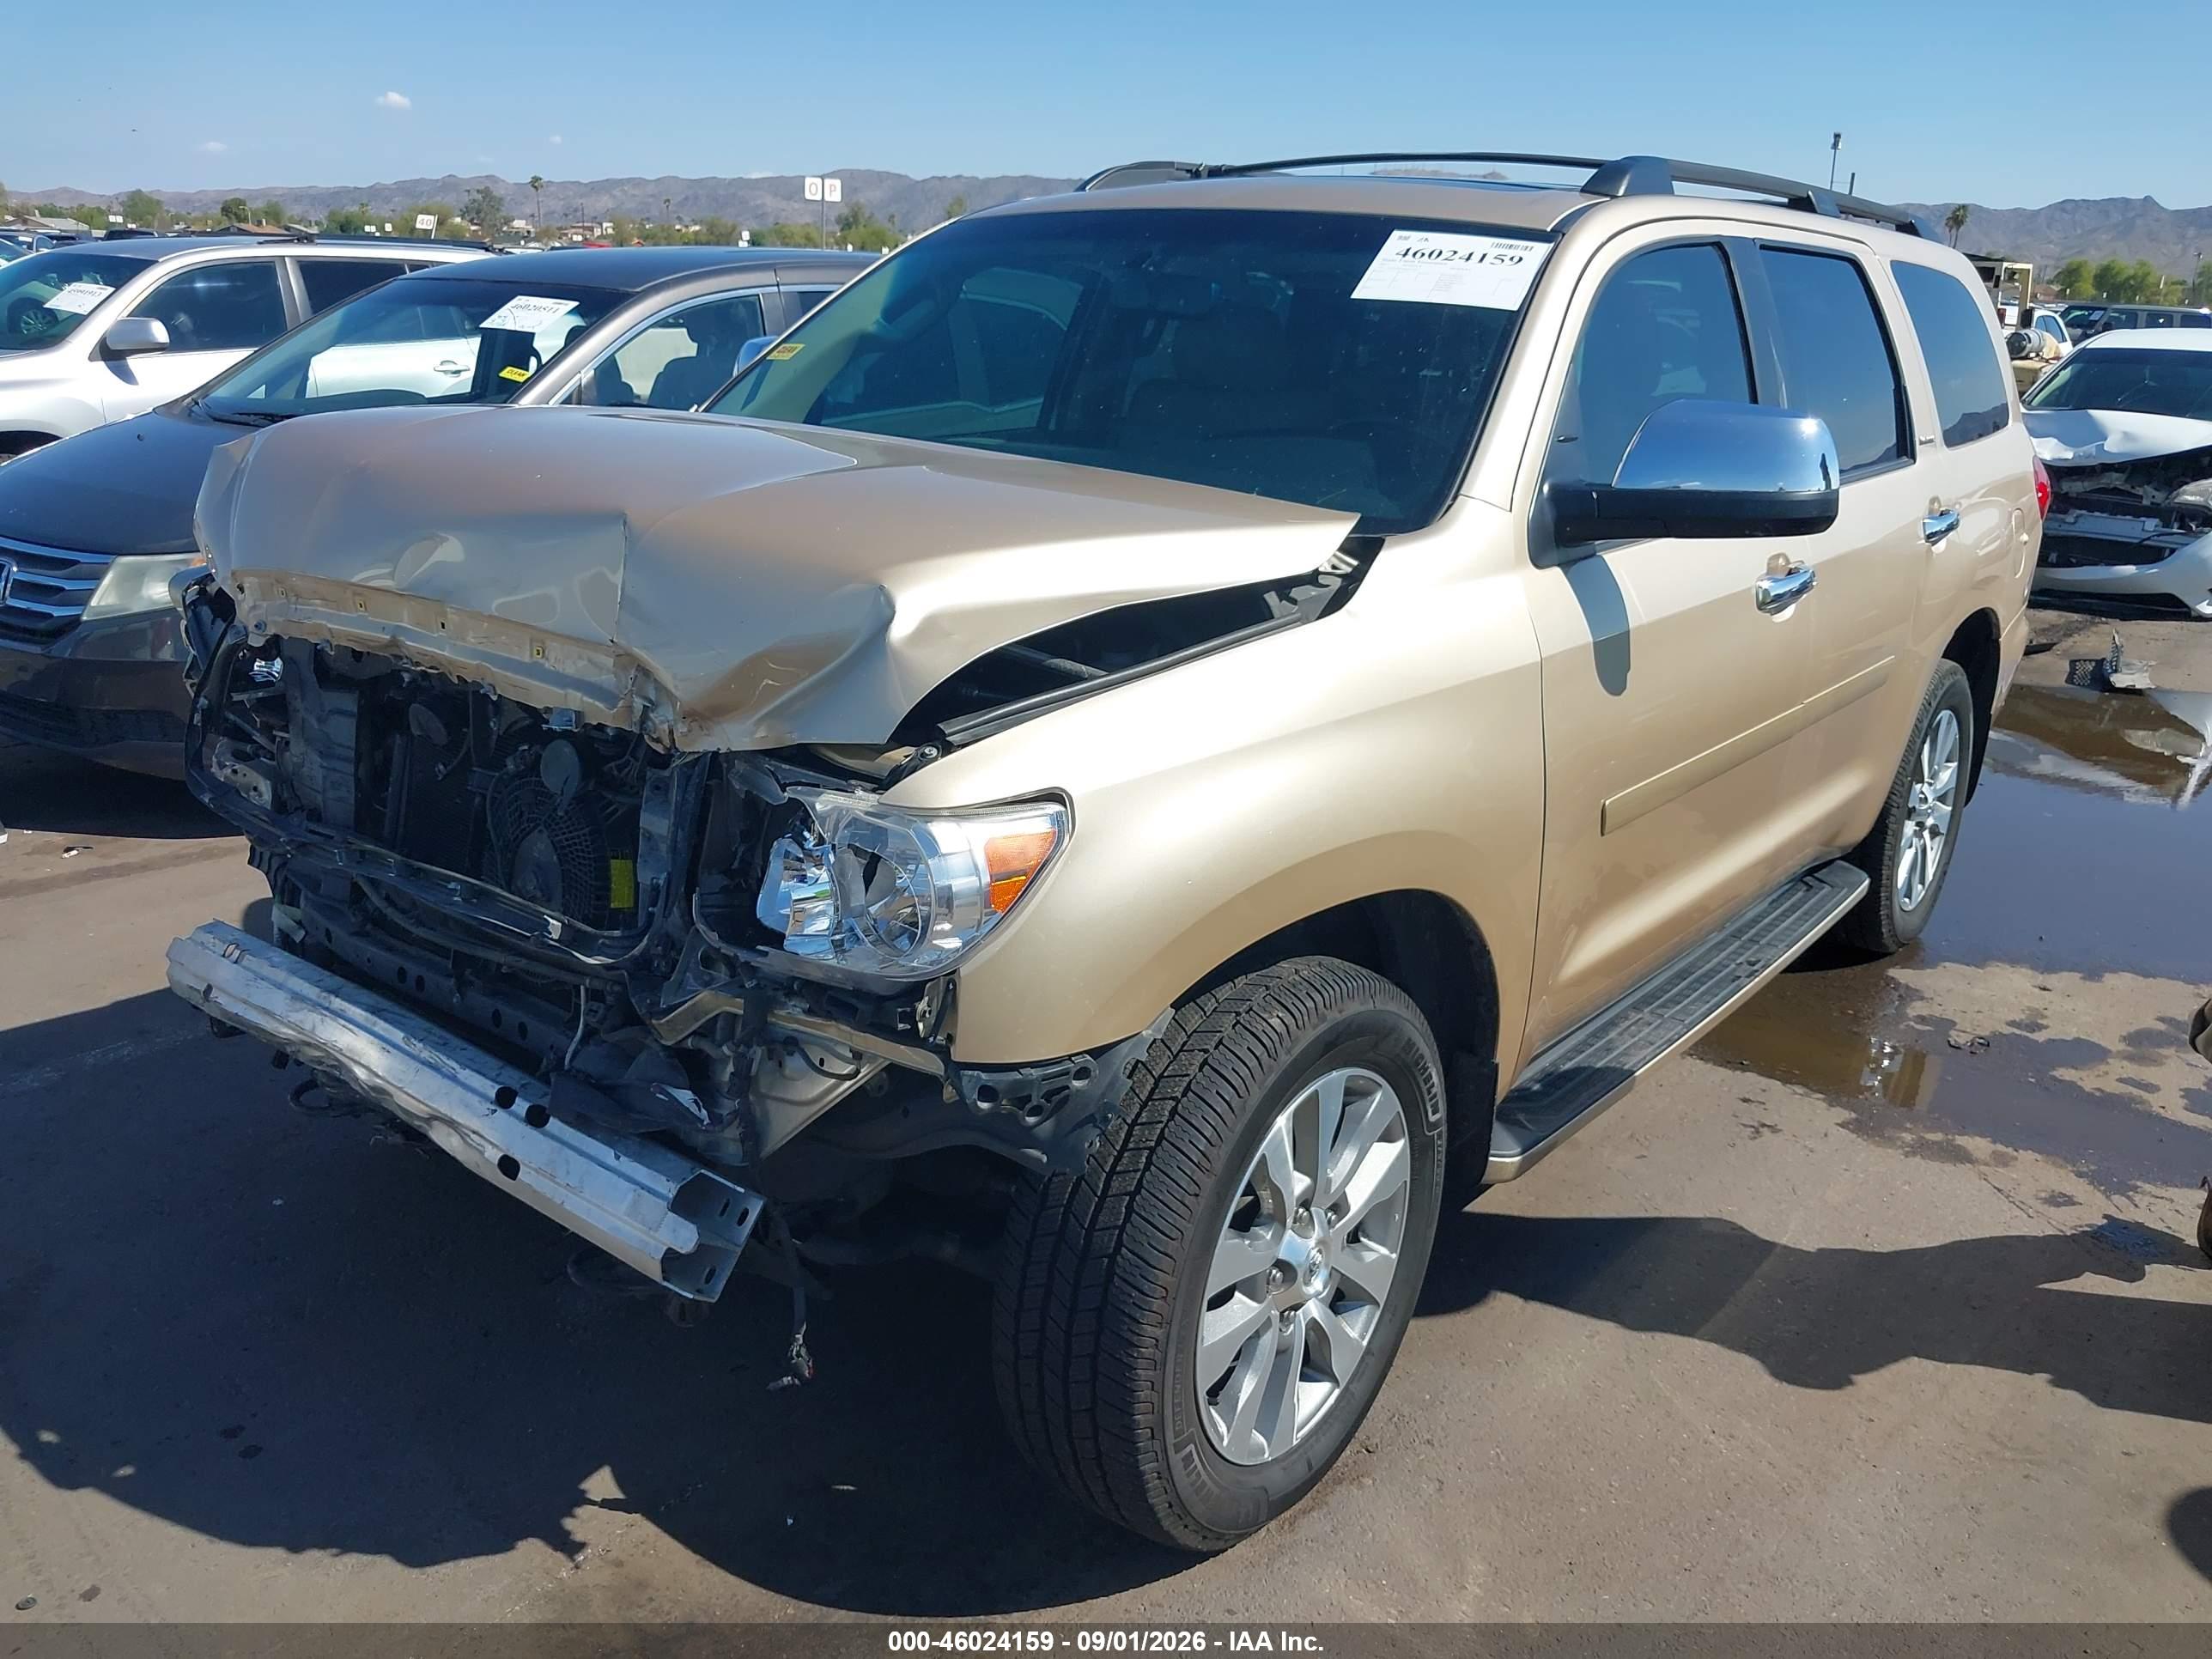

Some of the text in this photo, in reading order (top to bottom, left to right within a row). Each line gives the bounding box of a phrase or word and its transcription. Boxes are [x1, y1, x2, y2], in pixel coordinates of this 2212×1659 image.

[829, 183, 837, 198] P
[417, 217, 433, 228] 40
[1395, 246, 1524, 268] 46024159
[1399, 1036, 1441, 1118] MICHELIN
